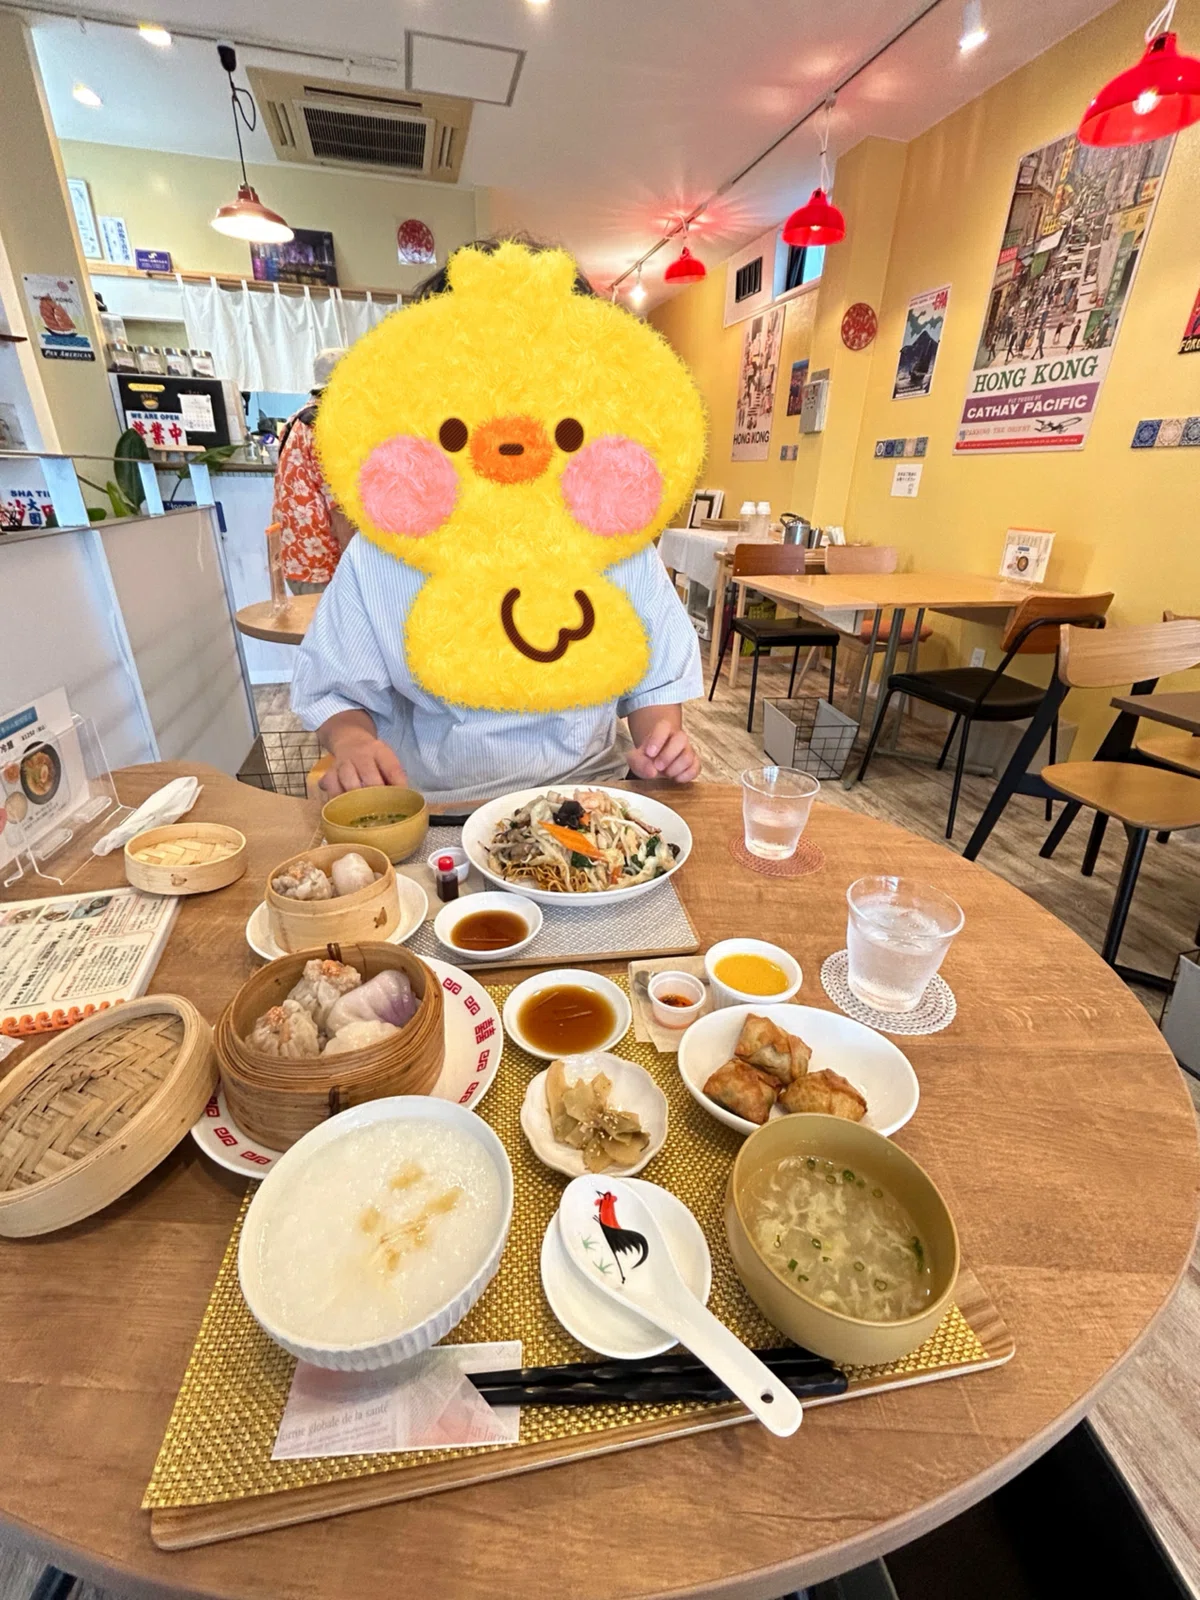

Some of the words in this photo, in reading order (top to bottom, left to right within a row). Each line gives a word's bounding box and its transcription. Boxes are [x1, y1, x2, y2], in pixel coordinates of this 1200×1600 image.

[60, 350, 92, 359] AMERICAN
[972, 367, 1027, 393] HONG
[1031, 355, 1099, 385] KONG
[967, 403, 1020, 419] CATHAY
[1023, 395, 1088, 414] PACIFIC
[160, 413, 180, 421] OPEN
[733, 432, 750, 445] HONG
[751, 430, 770, 444] KONG
[10, 490, 34, 498] SHA
[308, 1415, 339, 1436] globale
[341, 1412, 353, 1424] de
[355, 1410, 363, 1420] la
